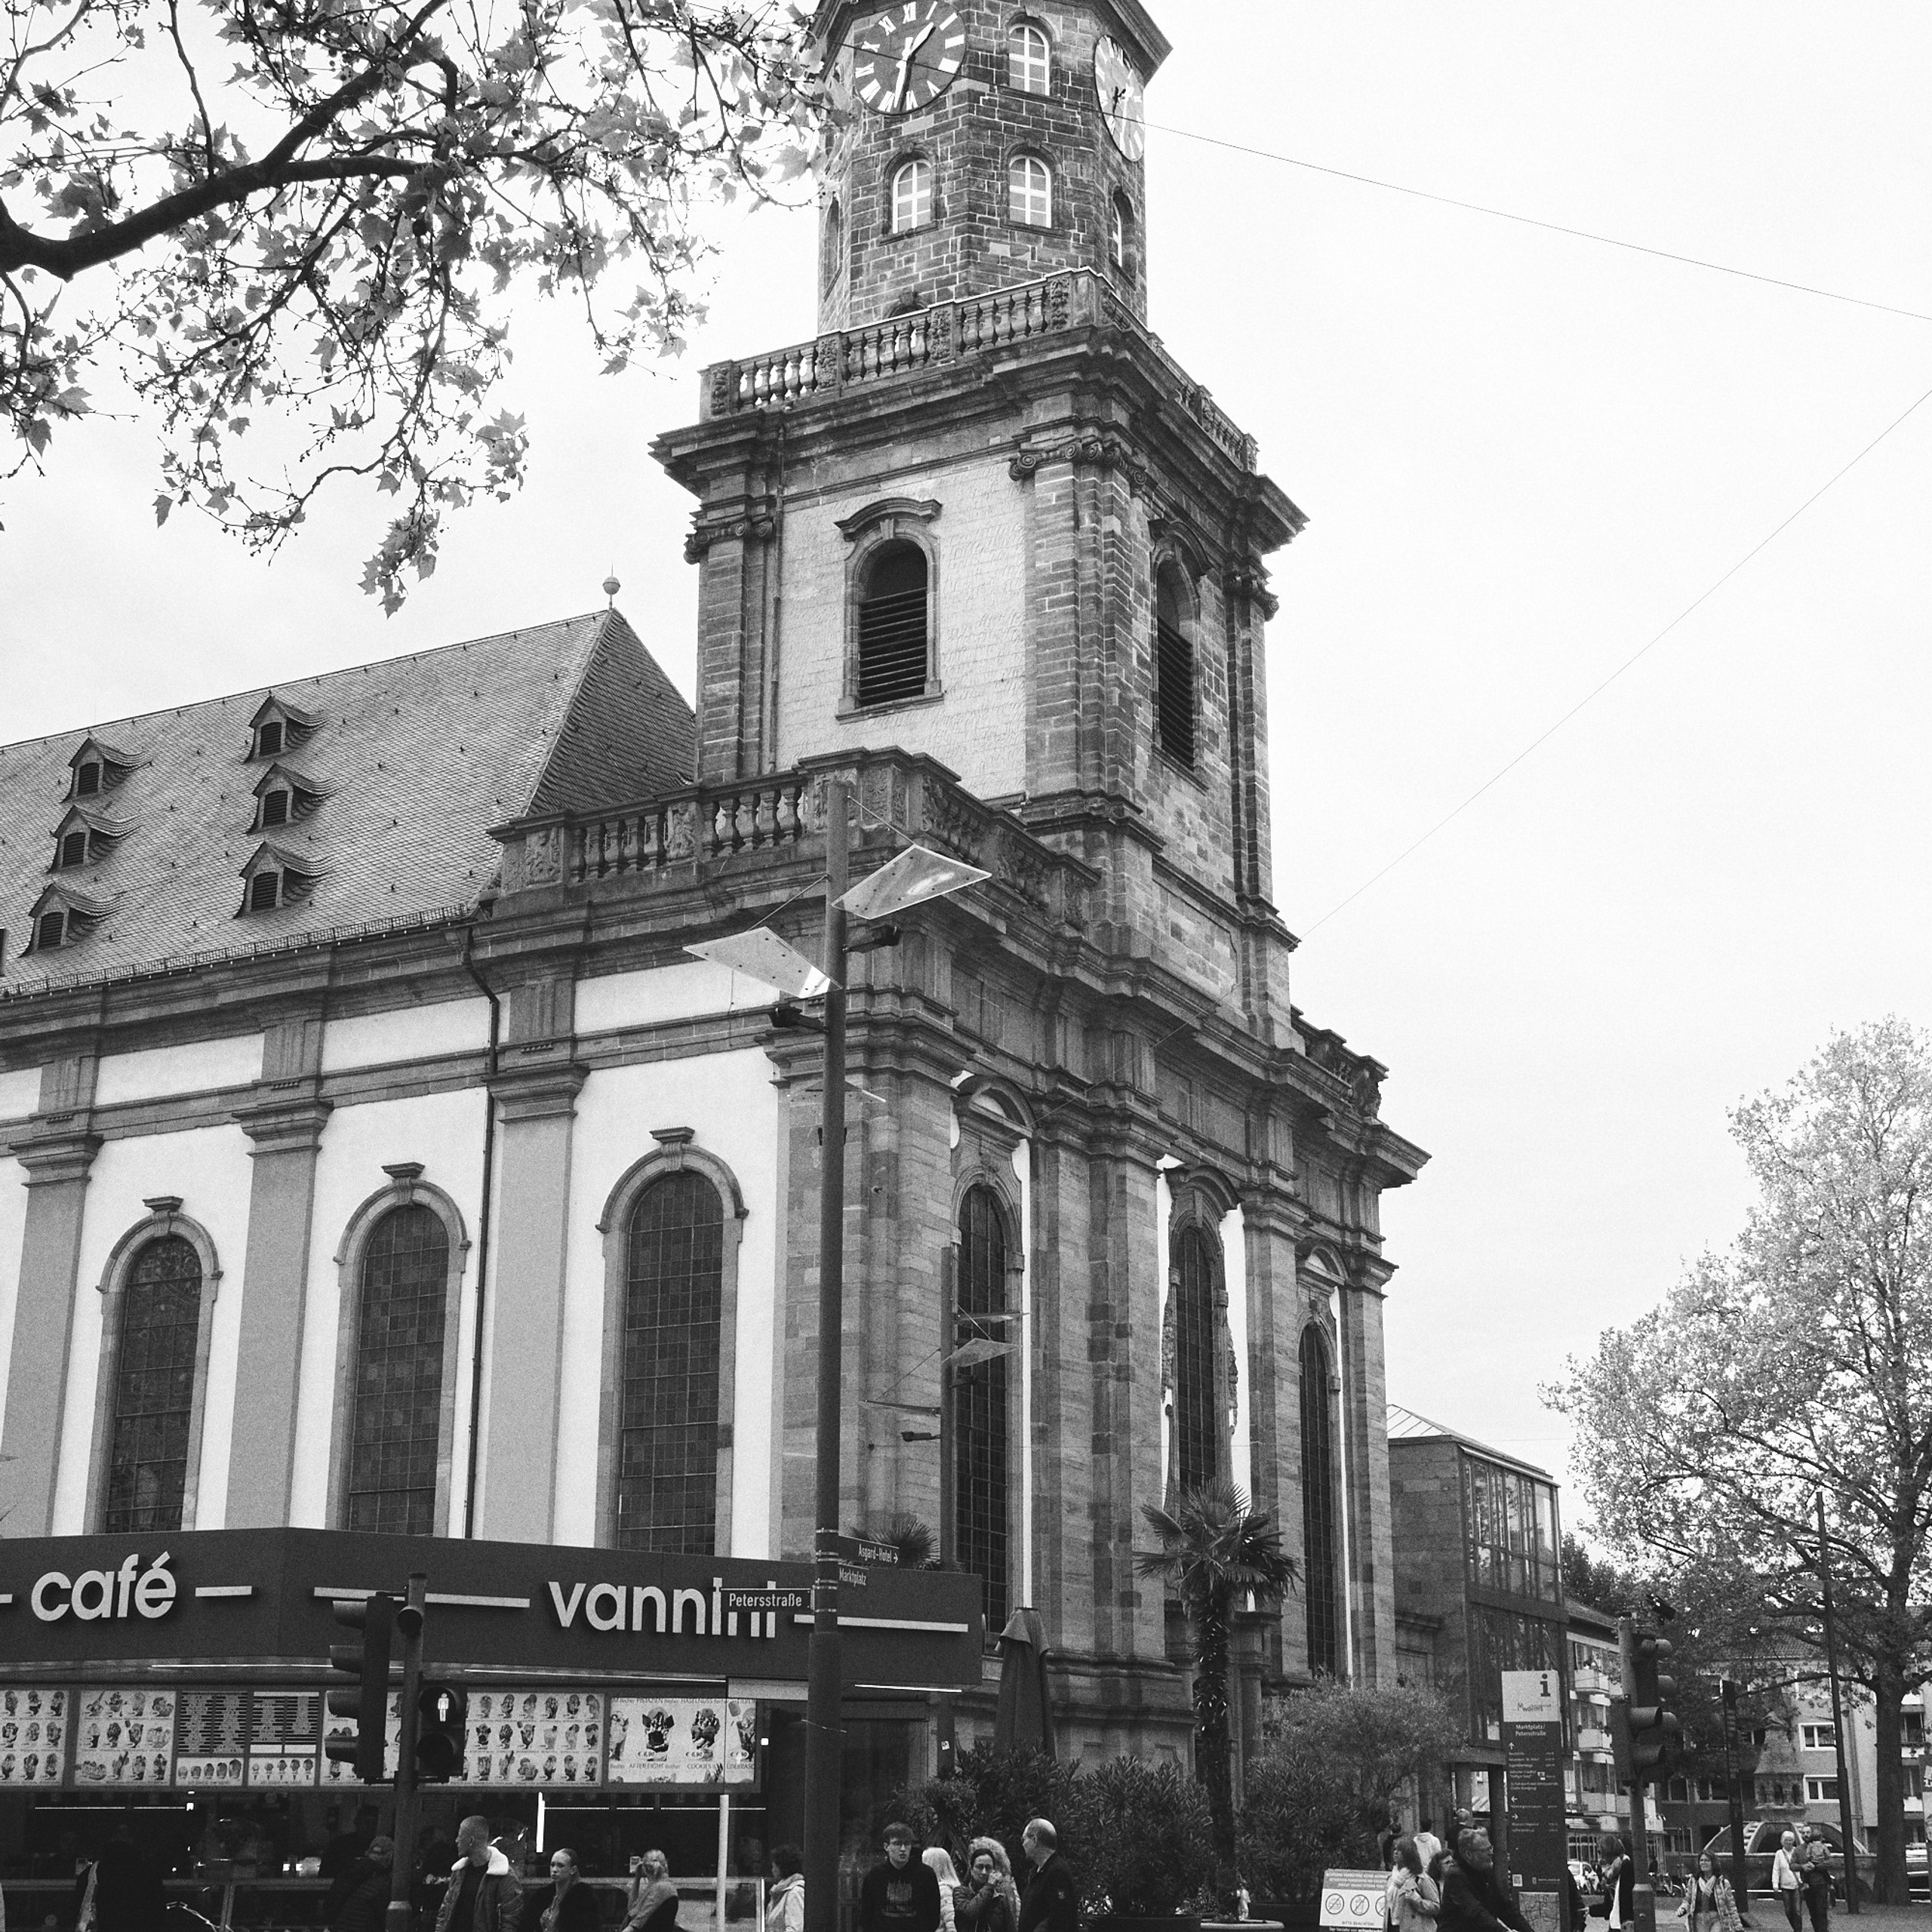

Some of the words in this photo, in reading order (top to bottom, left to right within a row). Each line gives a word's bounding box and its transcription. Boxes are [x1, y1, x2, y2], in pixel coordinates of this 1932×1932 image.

[858, 1543, 892, 1563] Asgard-Hotel
[31, 1551, 177, 1621] café
[839, 1567, 867, 1586] Marktplatz
[729, 1592, 802, 1607] Petersstraße
